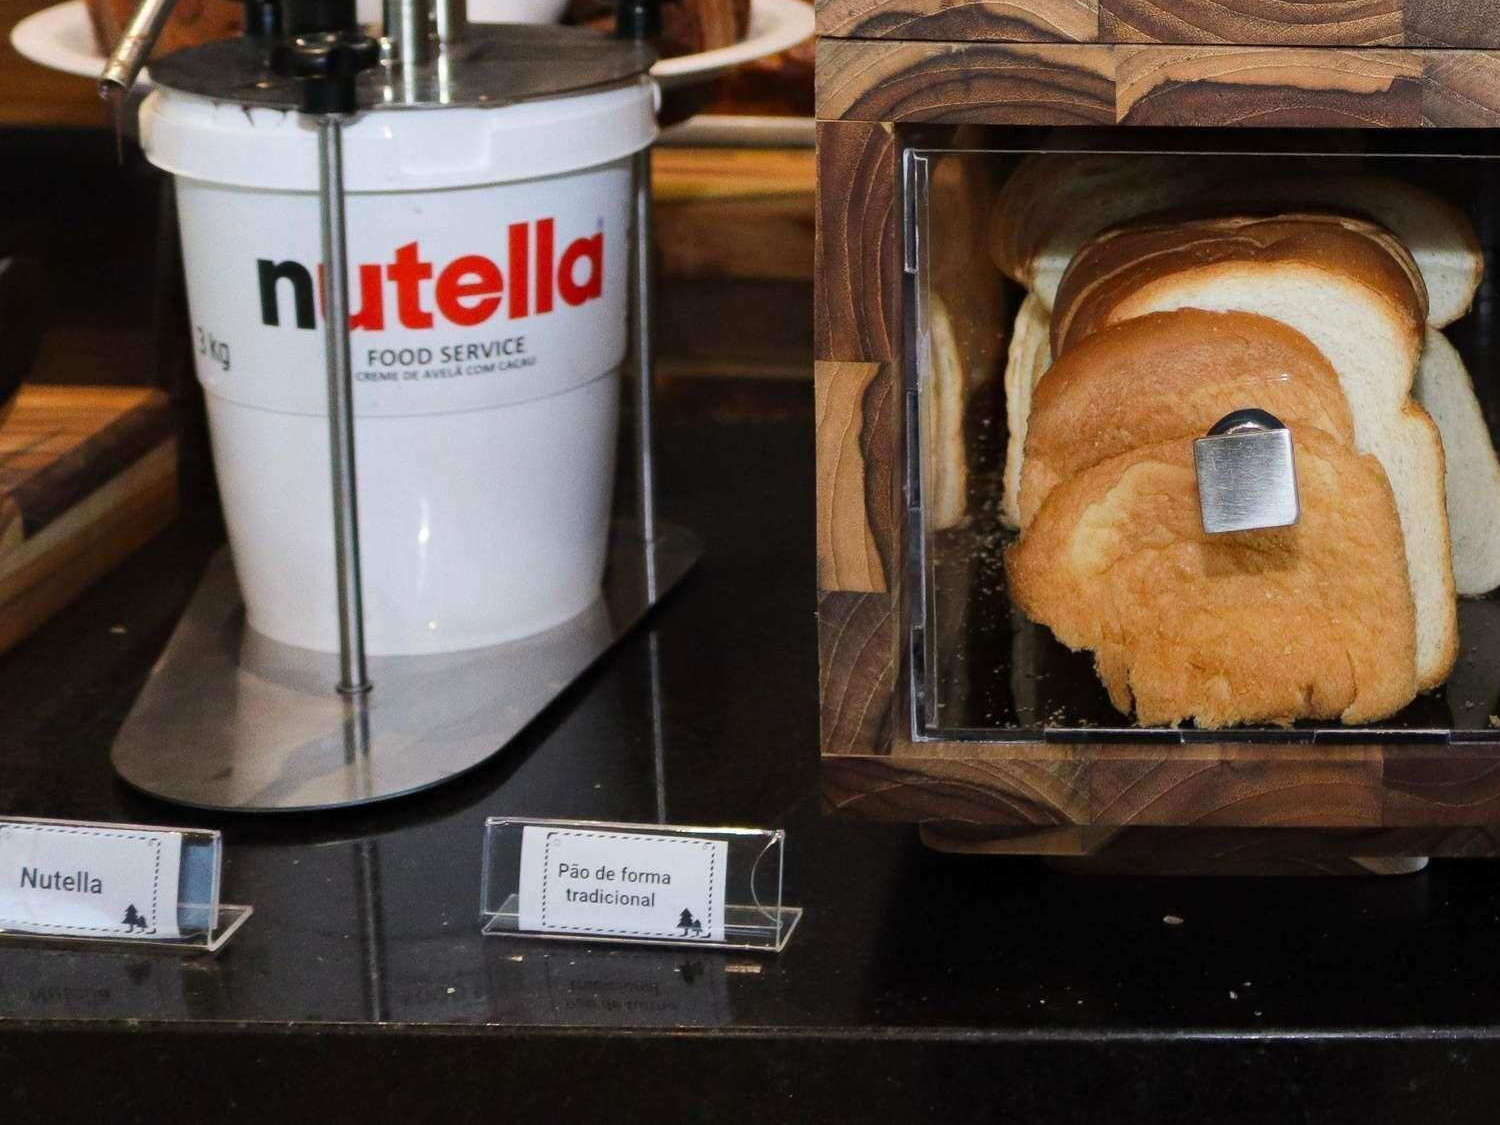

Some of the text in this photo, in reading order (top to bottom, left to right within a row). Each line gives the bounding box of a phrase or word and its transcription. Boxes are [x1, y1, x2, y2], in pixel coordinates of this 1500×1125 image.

[256, 217, 605, 332] nutella
[208, 331, 231, 371] kg
[367, 335, 526, 367] FOOD SERVICE
[20, 866, 103, 894] Nutella
[558, 863, 672, 885] Pão de forma
[566, 888, 656, 908] tradicional
